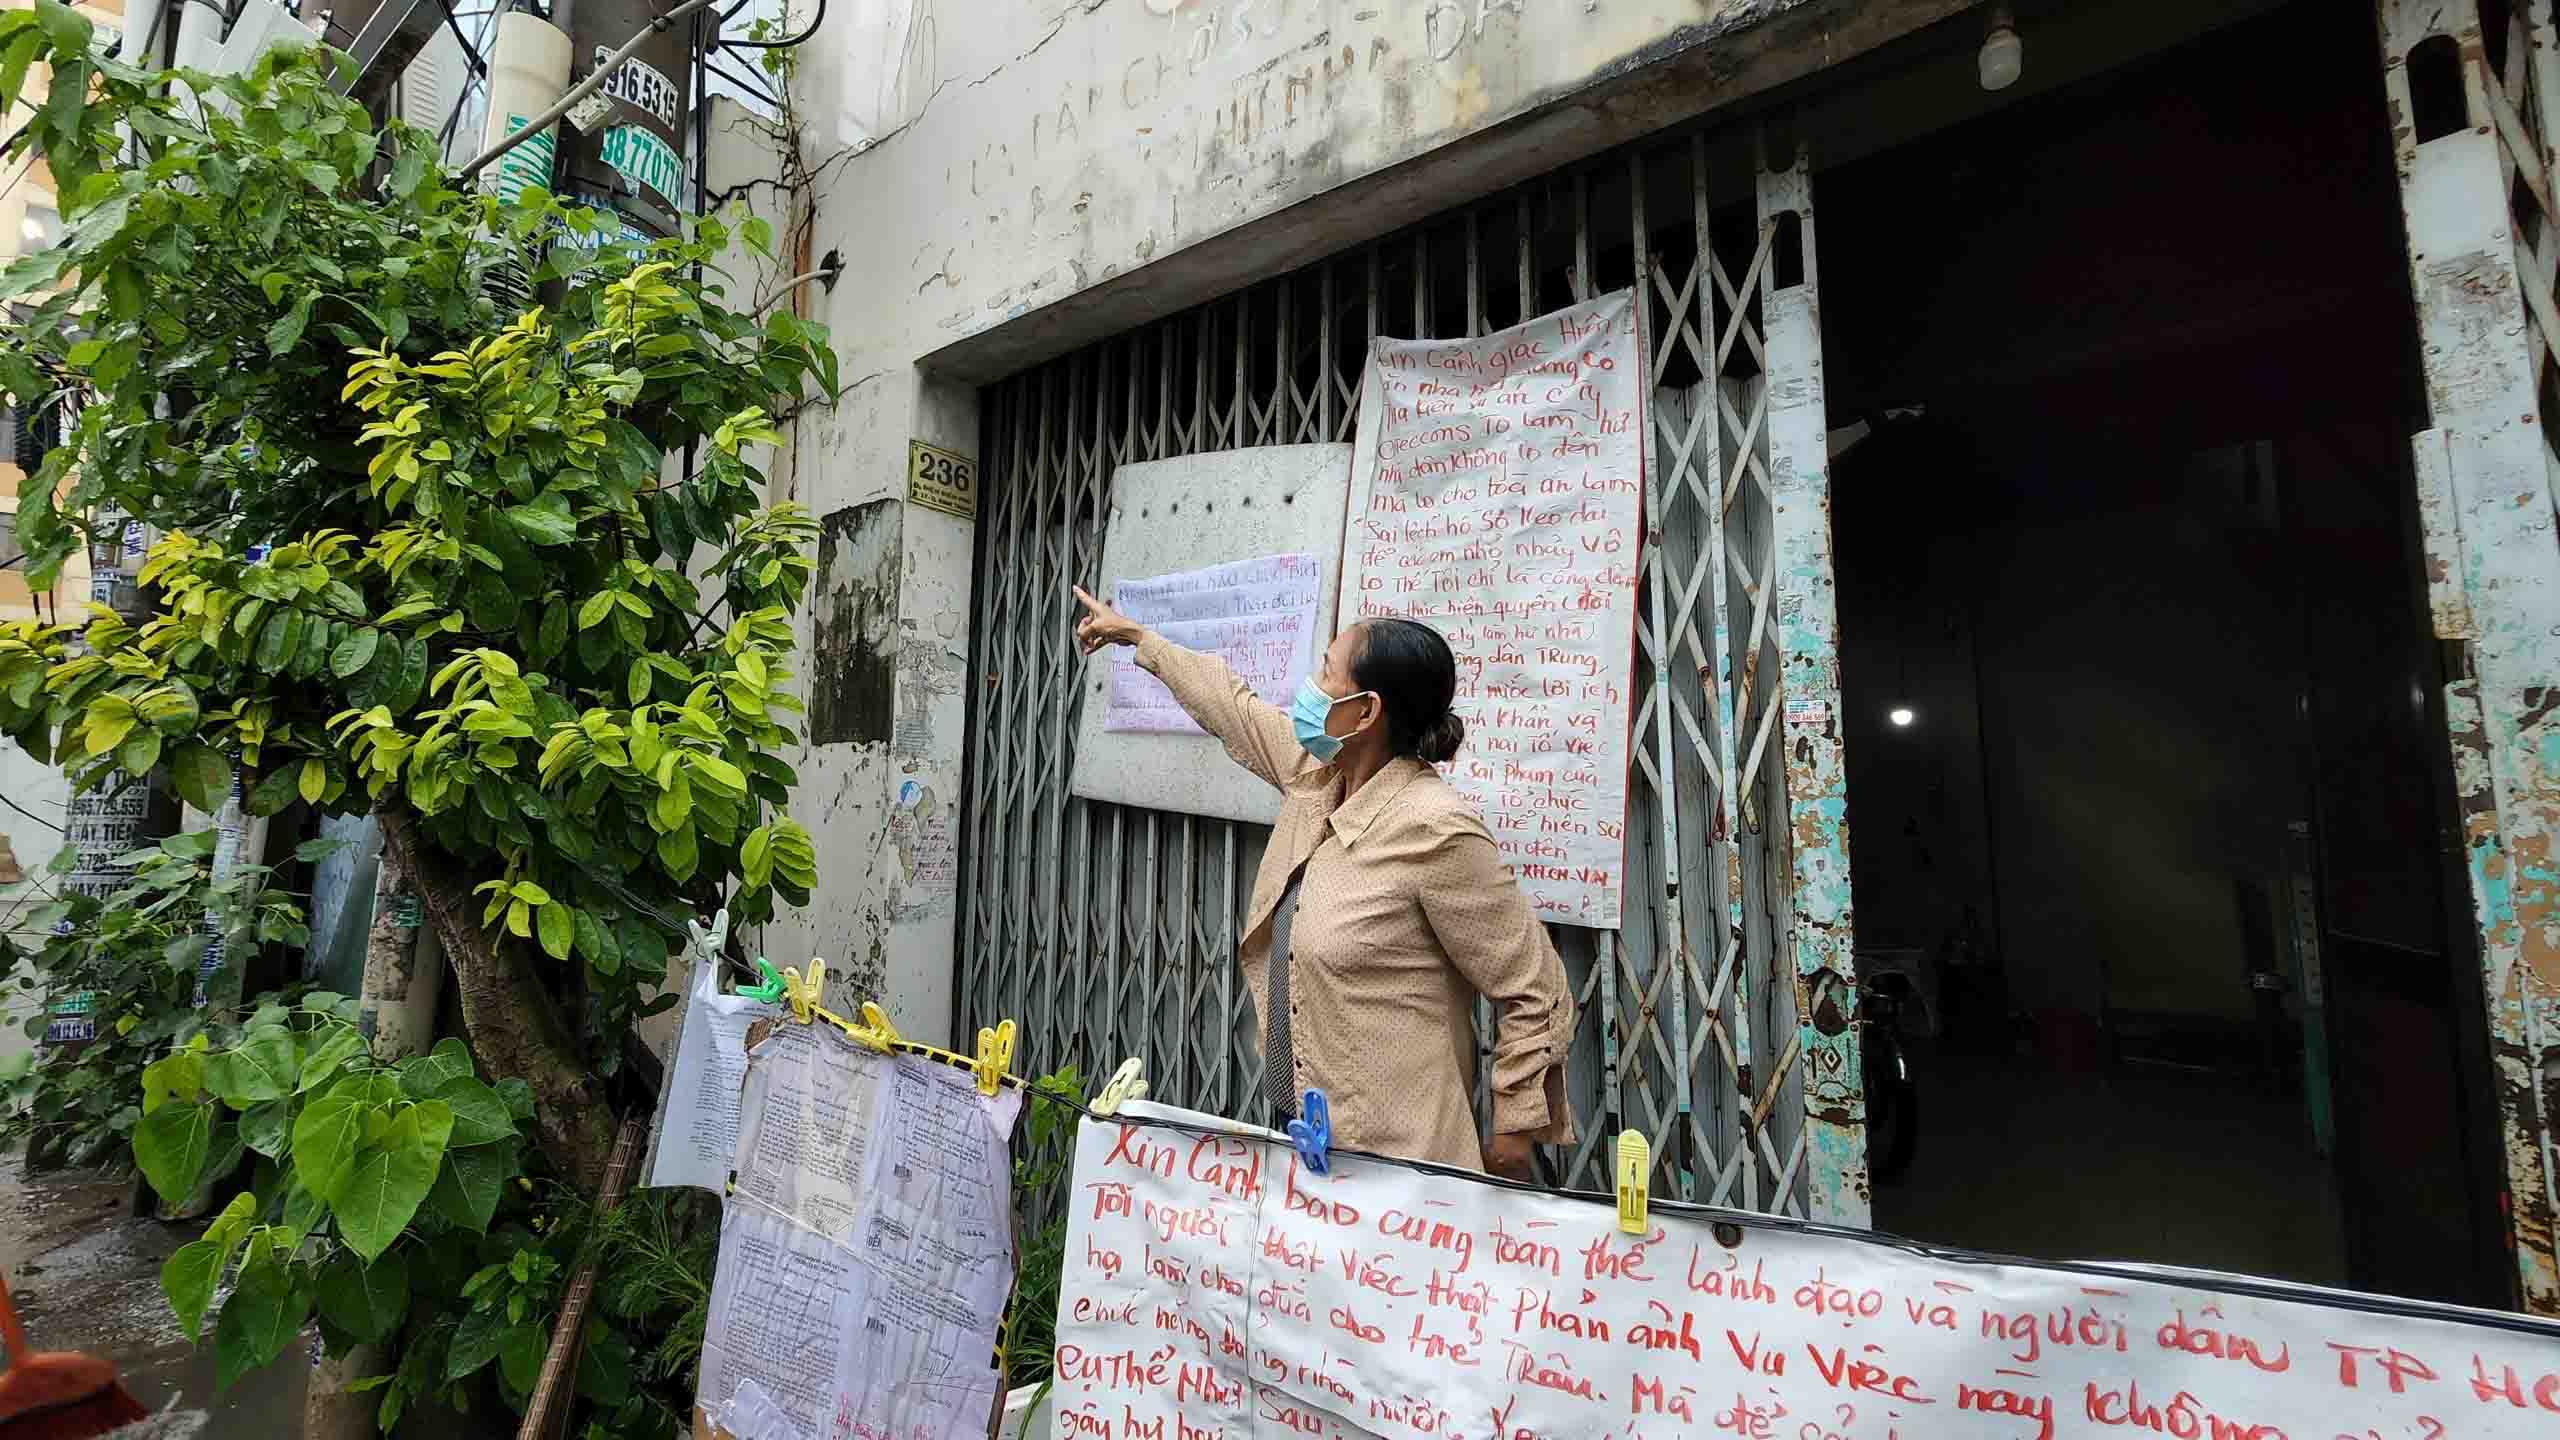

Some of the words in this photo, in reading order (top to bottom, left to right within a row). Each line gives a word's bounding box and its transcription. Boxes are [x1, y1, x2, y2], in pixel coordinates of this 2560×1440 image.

[920, 452, 969, 492] 236
[1488, 641, 1526, 666] dân
[1087, 1232, 1121, 1281] hạ
[1104, 1122, 1177, 1178] Xin
[1187, 1133, 1264, 1201] Cảnh
[1378, 1200, 1473, 1275] cùng
[1488, 1215, 1560, 1277] toàn
[1578, 1228, 1666, 1281] thể
[1794, 1265, 1884, 1328] đạo
[1905, 1280, 1974, 1331] và
[1981, 1286, 2129, 1363] người
[2156, 1304, 2290, 1374] dân
[2325, 1341, 2440, 1393] TP
[1959, 1367, 2054, 1440] này
